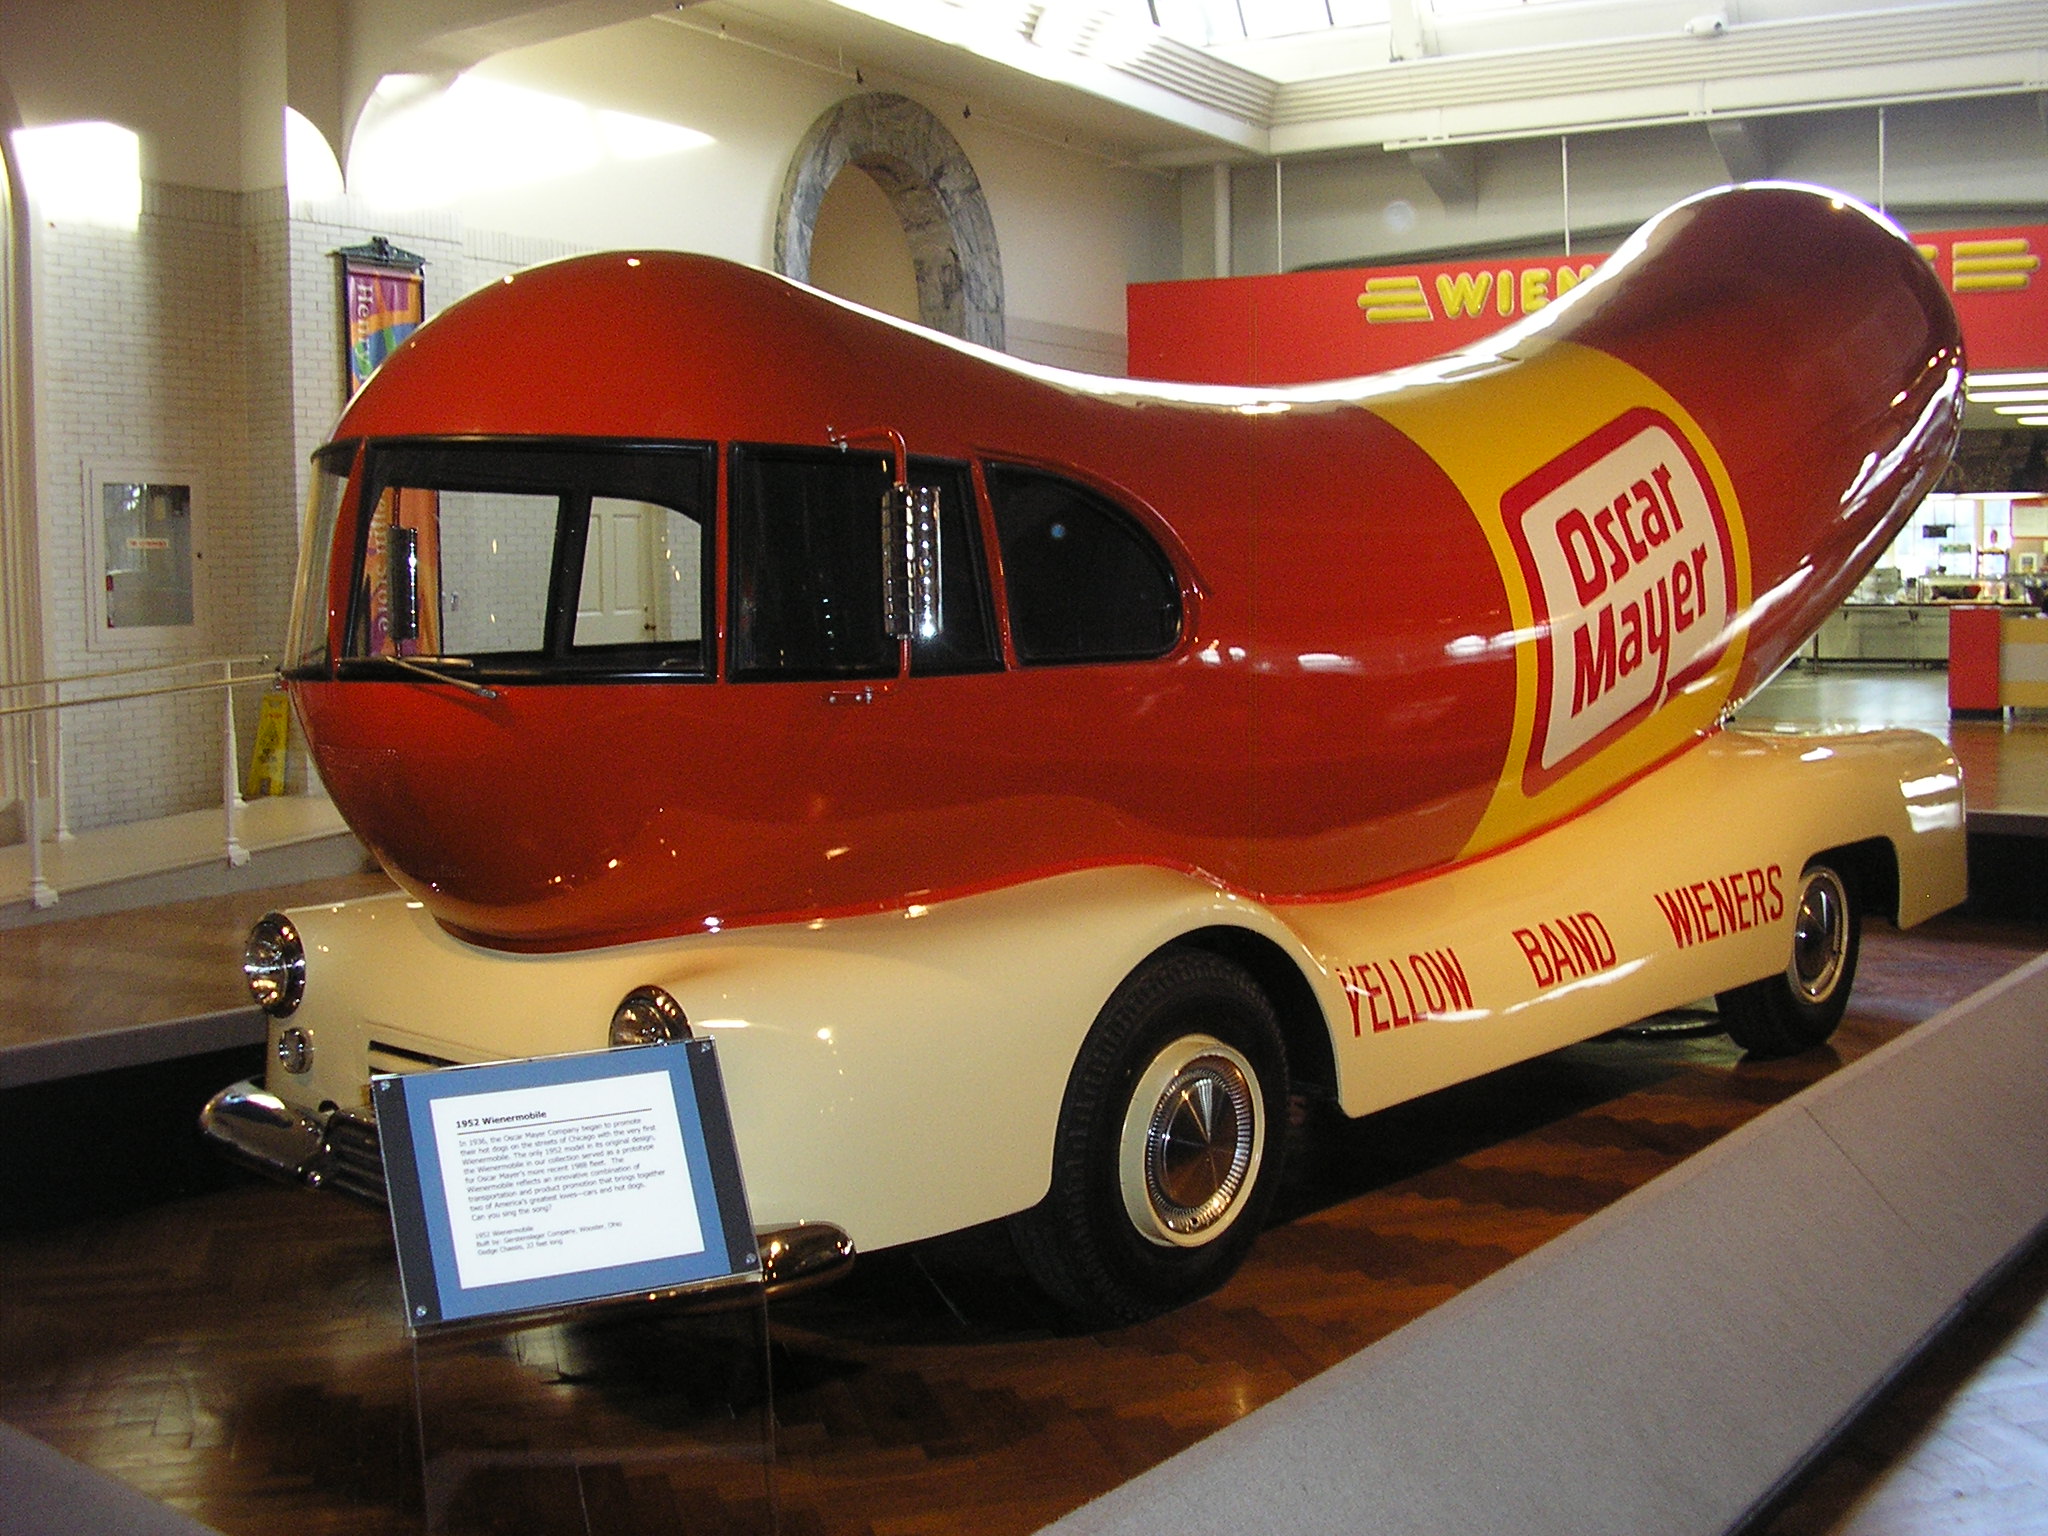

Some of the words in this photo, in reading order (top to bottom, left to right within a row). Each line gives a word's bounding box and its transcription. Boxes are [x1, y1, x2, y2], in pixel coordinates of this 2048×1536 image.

[354, 284, 374, 364] Henry
[1554, 462, 1684, 608] Oscar
[1570, 542, 1708, 719] Mayer
[1335, 947, 1474, 1037] YELLOW
[1511, 911, 1618, 989] BAND
[1653, 864, 1784, 950] WIENERS
[456, 1118, 479, 1128] 1952
[481, 1110, 547, 1124] Wienermobile
[503, 1132, 522, 1140] Oscar
[524, 1129, 545, 1139] Mayer
[547, 1125, 579, 1136] Company
[580, 1122, 603, 1132] began
[612, 1117, 641, 1127] promote
[491, 1144, 508, 1153] dogs
[533, 1137, 557, 1146] streets
[567, 1132, 596, 1143] Chicago
[626, 1127, 641, 1135] very
[527, 1148, 542, 1157] only
[544, 1145, 562, 1153] 1952
[563, 1142, 585, 1150] model
[604, 1136, 630, 1146] original
[463, 1166, 475, 1174] the
[477, 1160, 523, 1172] Wienermobile
[547, 1152, 579, 1162] collection
[581, 1149, 604, 1158] served
[621, 1142, 655, 1153] prototype
[476, 1173, 496, 1181] Oscar
[546, 1163, 569, 1172] recent
[515, 1176, 541, 1185] reflects
[590, 1164, 631, 1175] combination
[532, 1183, 560, 1193] product
[561, 1178, 596, 1189] promotion
[598, 1175, 612, 1183] that
[613, 1172, 635, 1182] brings
[636, 1168, 665, 1179] together
[469, 1203, 483, 1211] two
[528, 1193, 557, 1204] greatest
[471, 1212, 485, 1220] Can
[501, 1208, 516, 1217] sing
